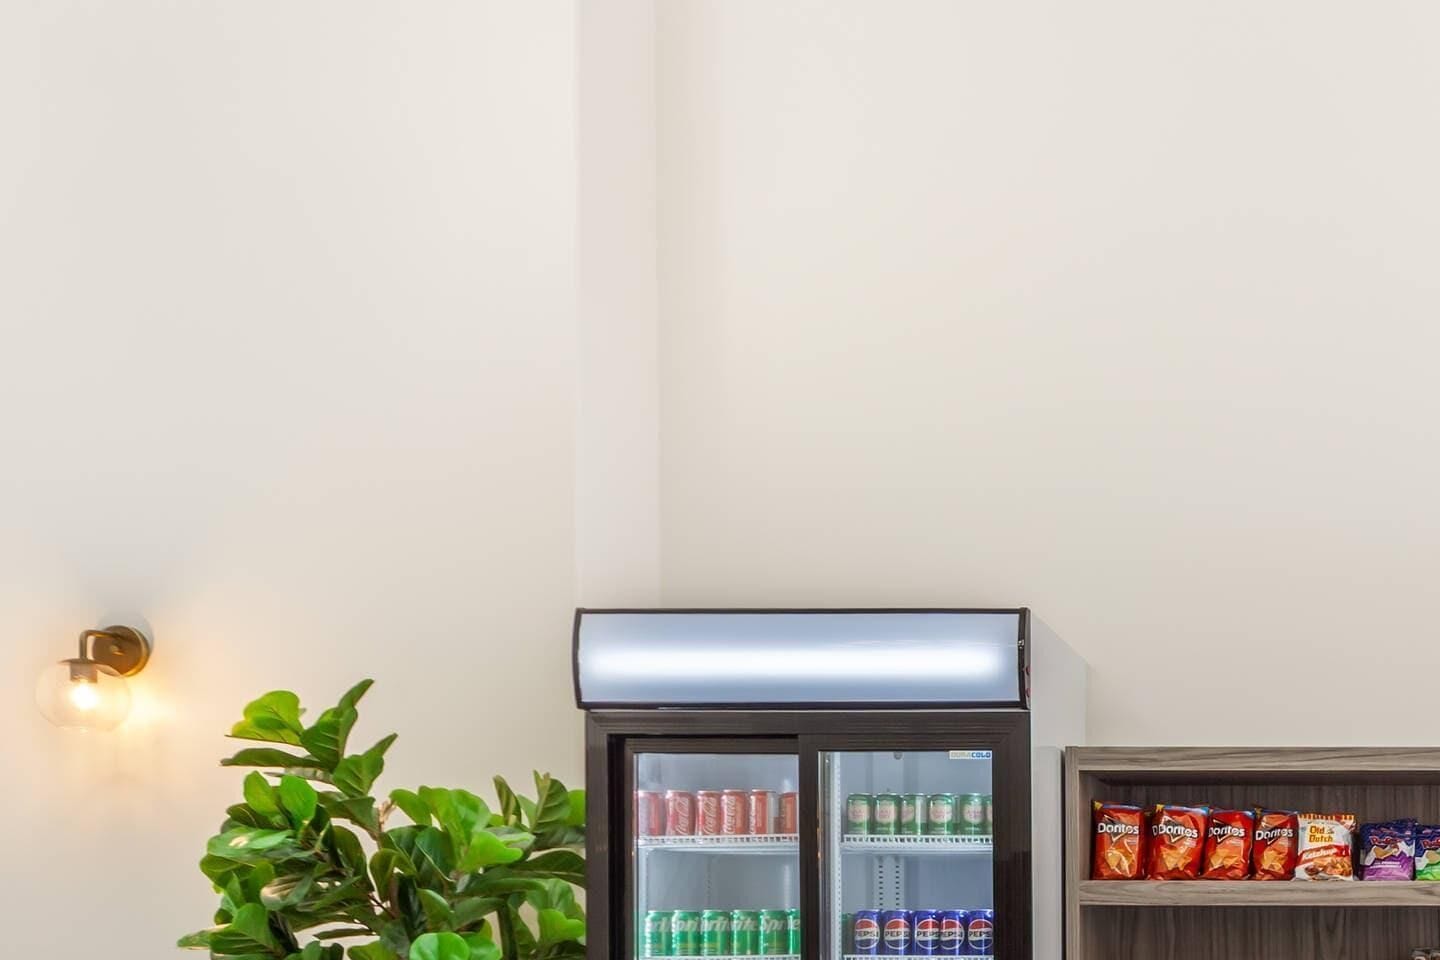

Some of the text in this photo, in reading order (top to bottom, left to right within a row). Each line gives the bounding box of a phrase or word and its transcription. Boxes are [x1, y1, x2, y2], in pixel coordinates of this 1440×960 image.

[1098, 822, 1139, 834] Doritos
[1159, 824, 1198, 838] Doritos
[1208, 825, 1245, 837] Doritos
[1309, 825, 1325, 834] Old
[1255, 828, 1293, 841] Doritos
[1309, 834, 1333, 843] Dutch
